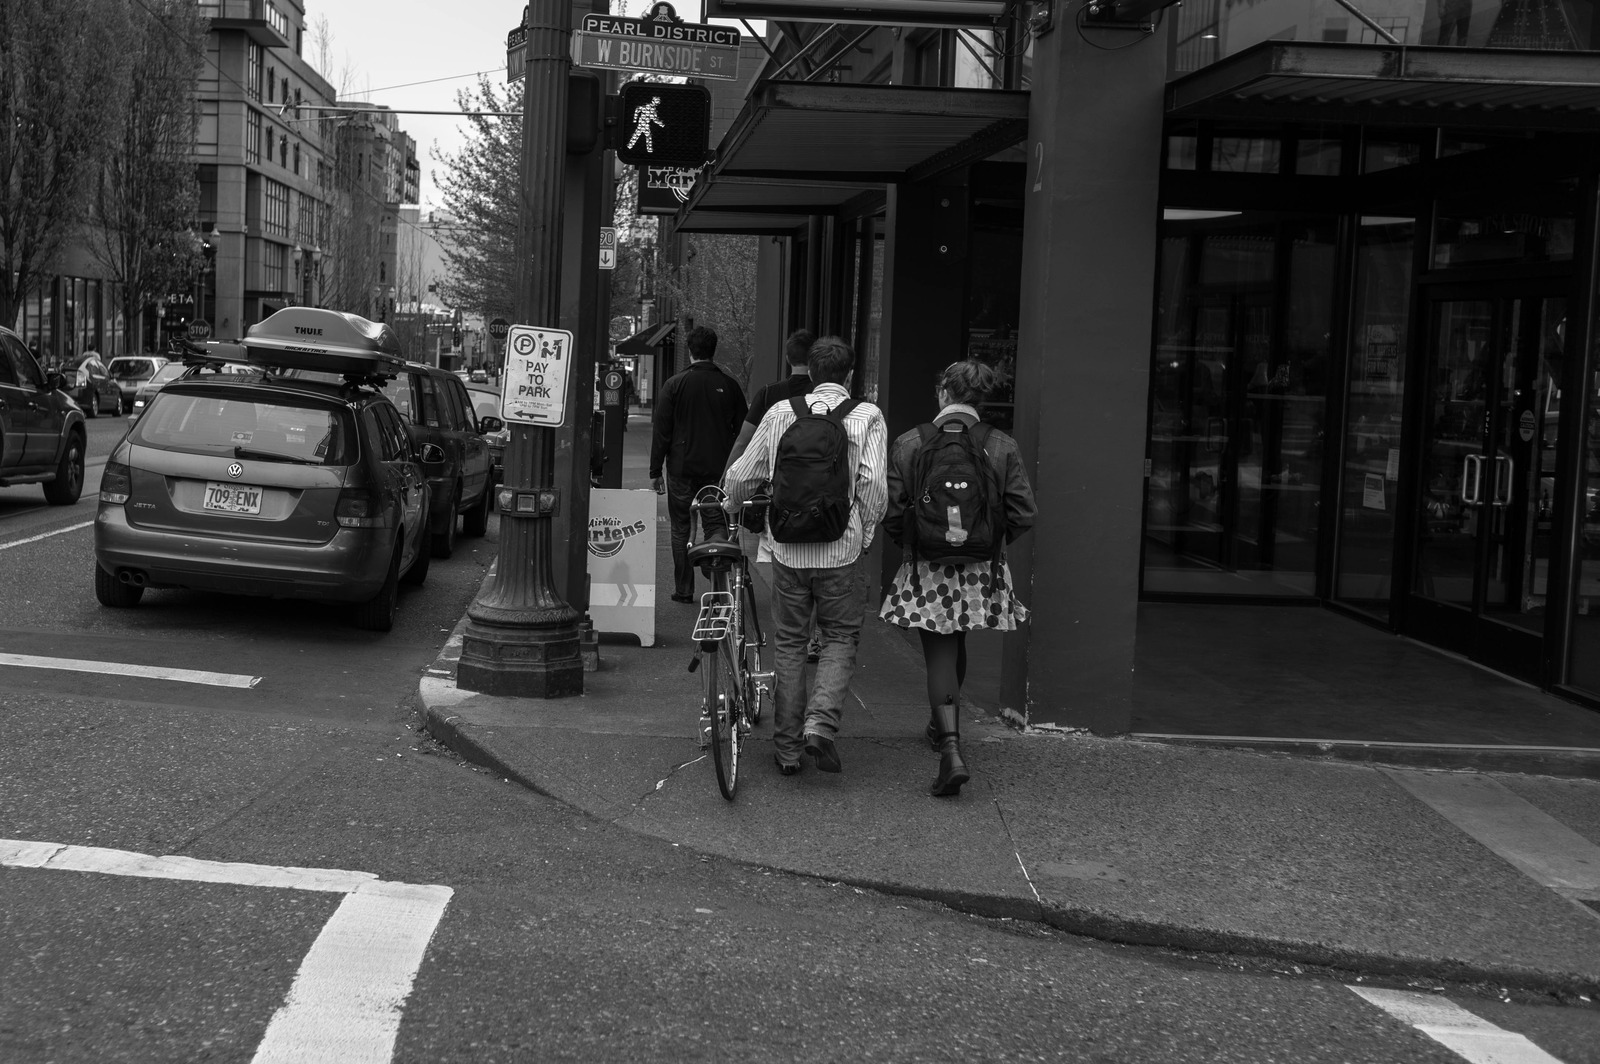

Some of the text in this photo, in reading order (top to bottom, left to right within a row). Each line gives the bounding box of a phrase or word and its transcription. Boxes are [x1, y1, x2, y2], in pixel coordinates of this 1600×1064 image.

[587, 18, 738, 45] PEARL DISTRICT
[509, 30, 524, 48] PEARL
[597, 39, 724, 71] W BURNSIDE ST
[1033, 141, 1043, 192] 2
[647, 168, 698, 189] Mar
[600, 231, 614, 245] 90
[190, 327, 209, 335] STOP
[294, 326, 323, 336] THULE
[490, 324, 508, 334] STOP
[520, 338, 531, 351] P
[526, 360, 549, 373] PAY
[528, 373, 544, 385] TO
[610, 375, 618, 387] P
[519, 385, 551, 399] PARK
[605, 391, 618, 402] 90
[208, 488, 230, 504] 709
[236, 491, 259, 508] ENX
